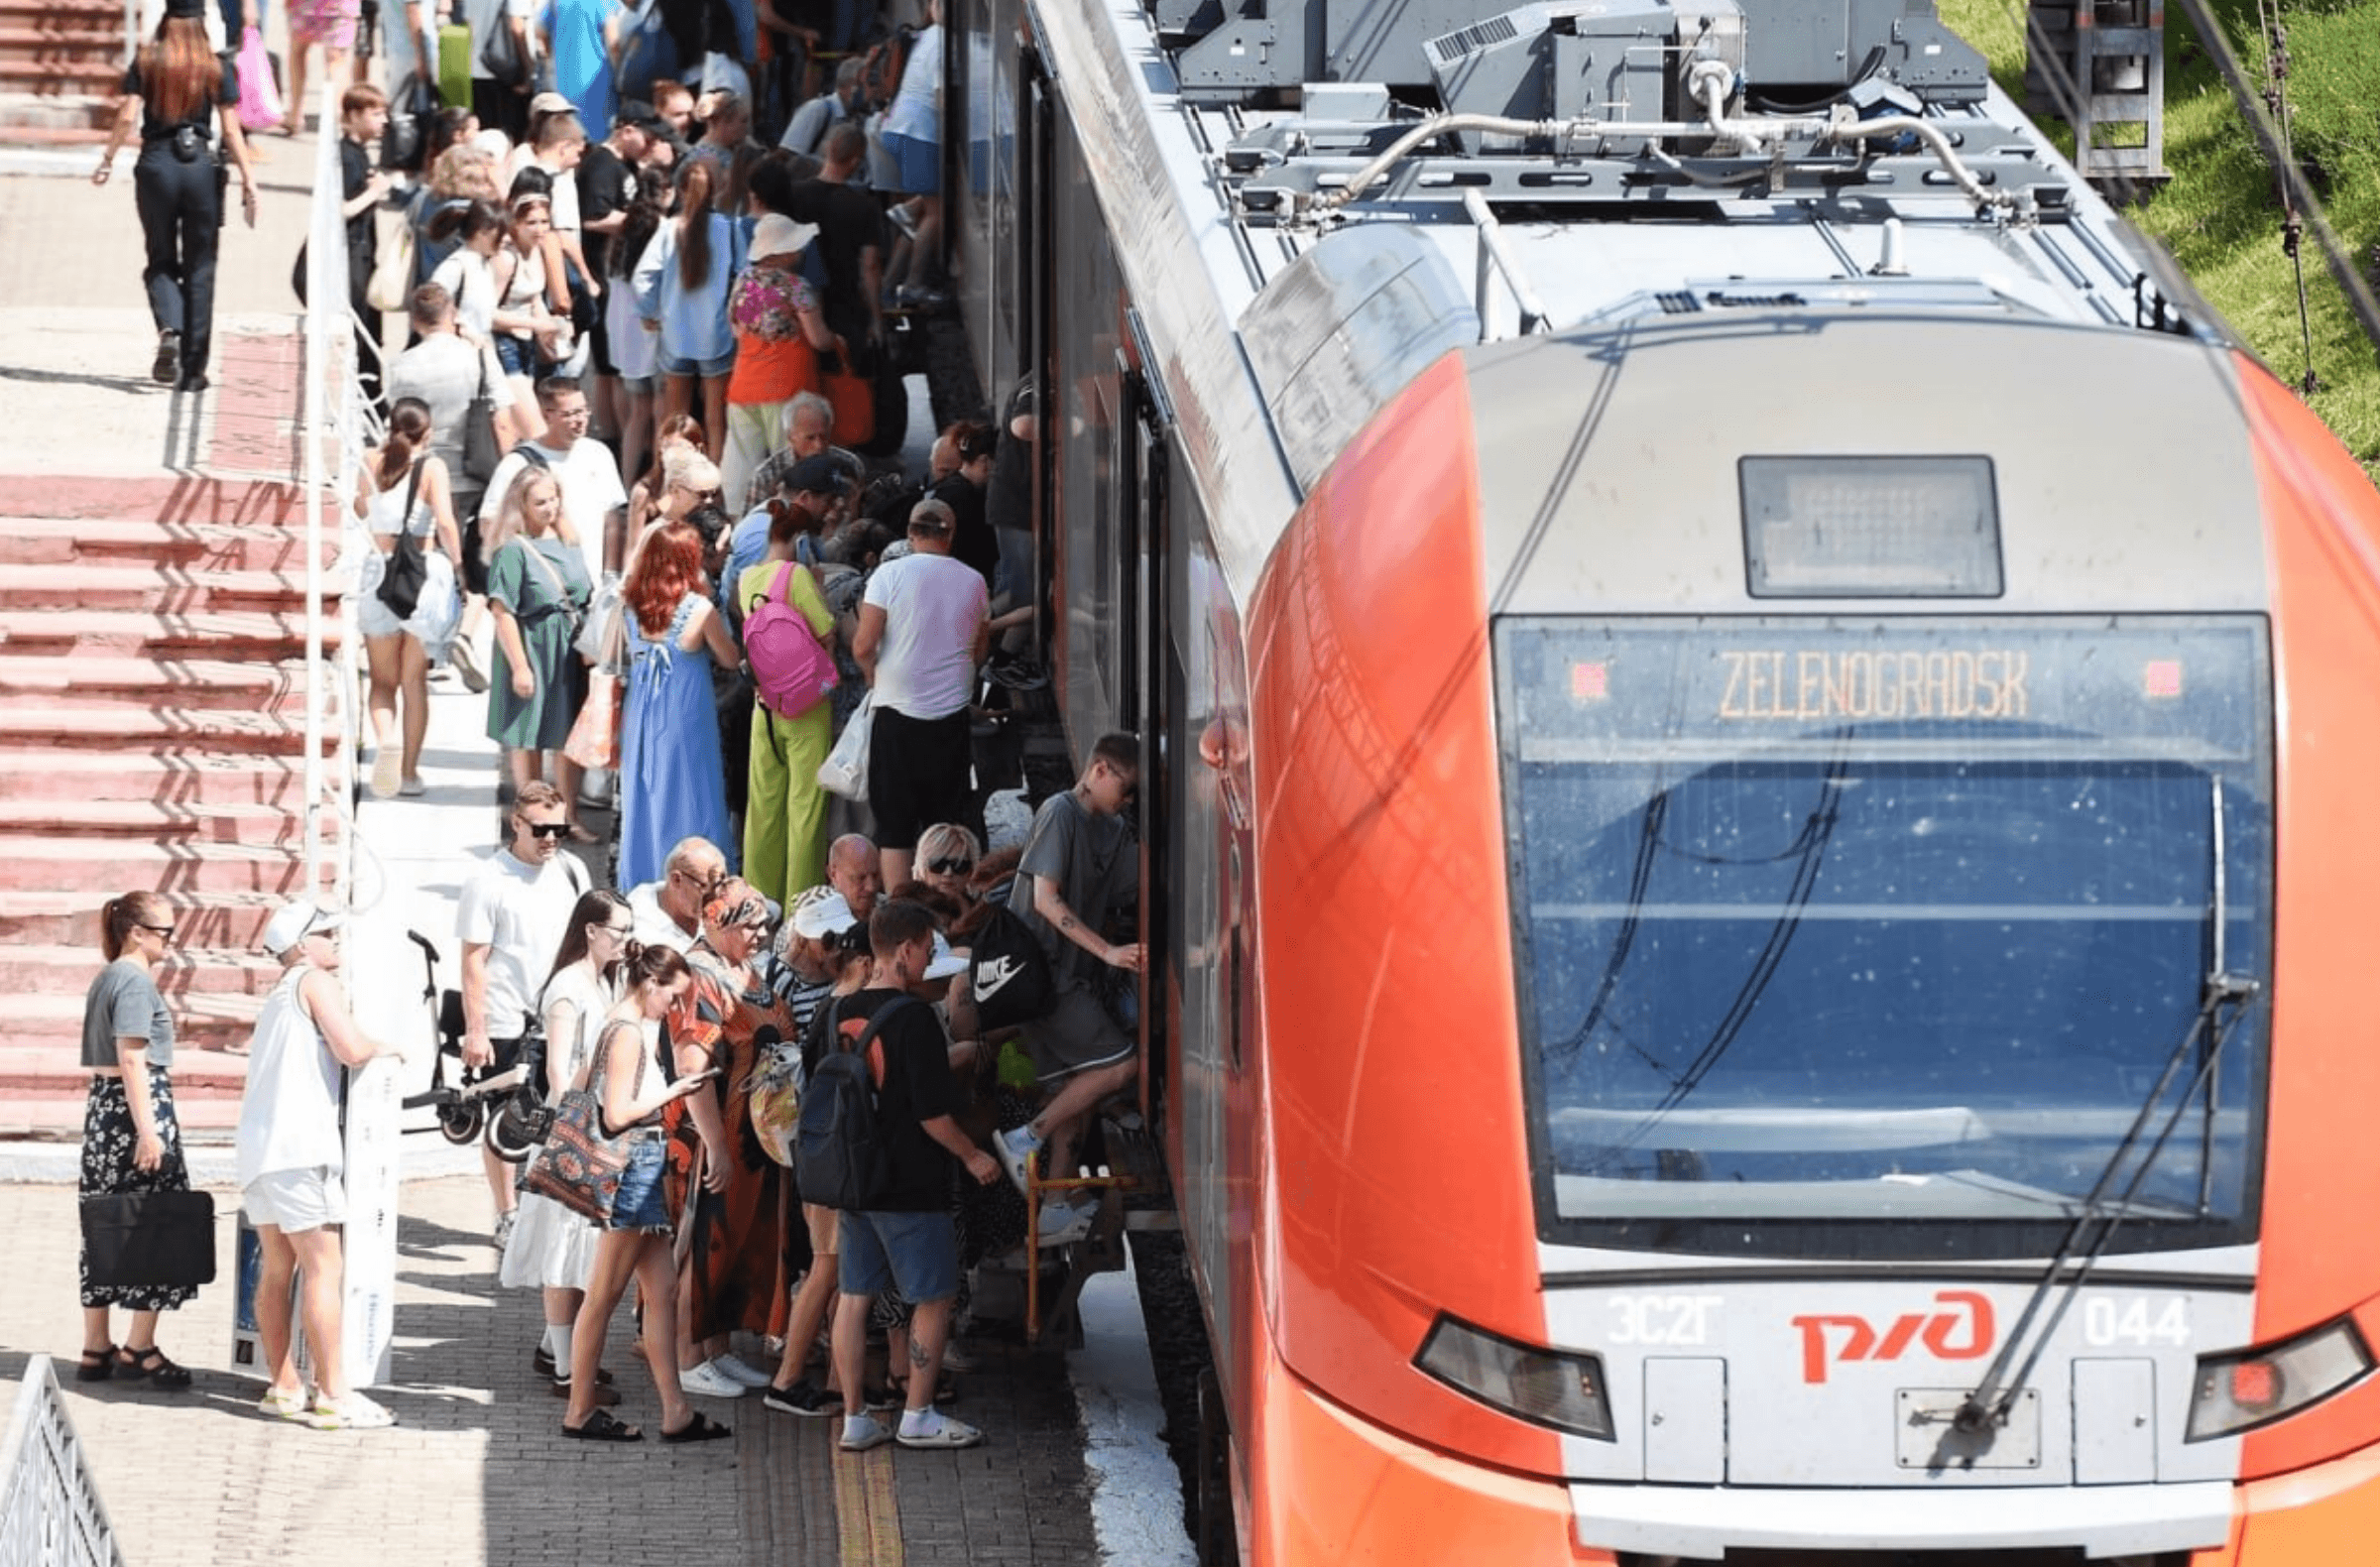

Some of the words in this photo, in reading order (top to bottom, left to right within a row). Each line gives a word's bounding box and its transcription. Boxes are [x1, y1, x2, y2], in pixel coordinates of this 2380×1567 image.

[1720, 651, 2029, 718] ZELENOGRADSK
[977, 955, 1012, 984] NIKE
[2084, 1296, 2192, 1348] 044
